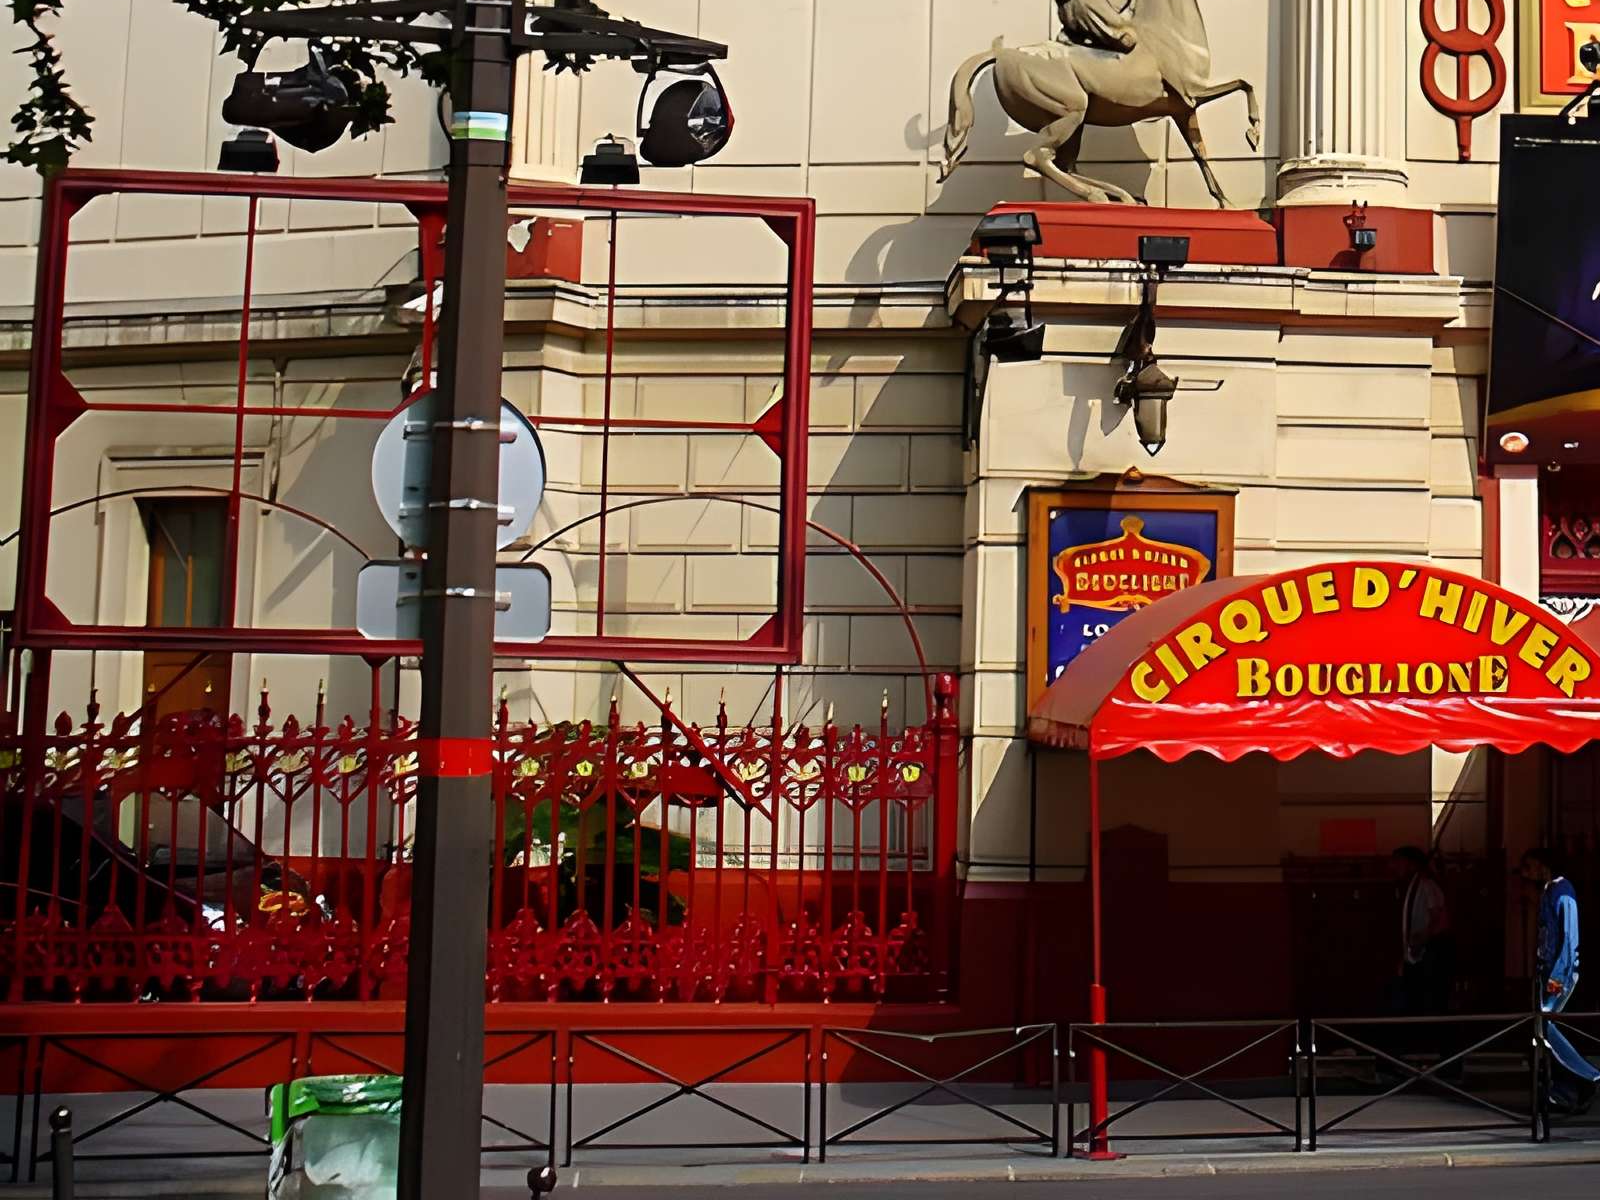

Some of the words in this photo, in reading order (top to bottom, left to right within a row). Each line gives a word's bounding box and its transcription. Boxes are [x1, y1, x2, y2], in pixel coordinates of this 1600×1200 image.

[1131, 572, 1339, 702] CIRQUE
[1352, 567, 1591, 697] D'HIVER
[1237, 656, 1509, 697] BOUGLIONE
